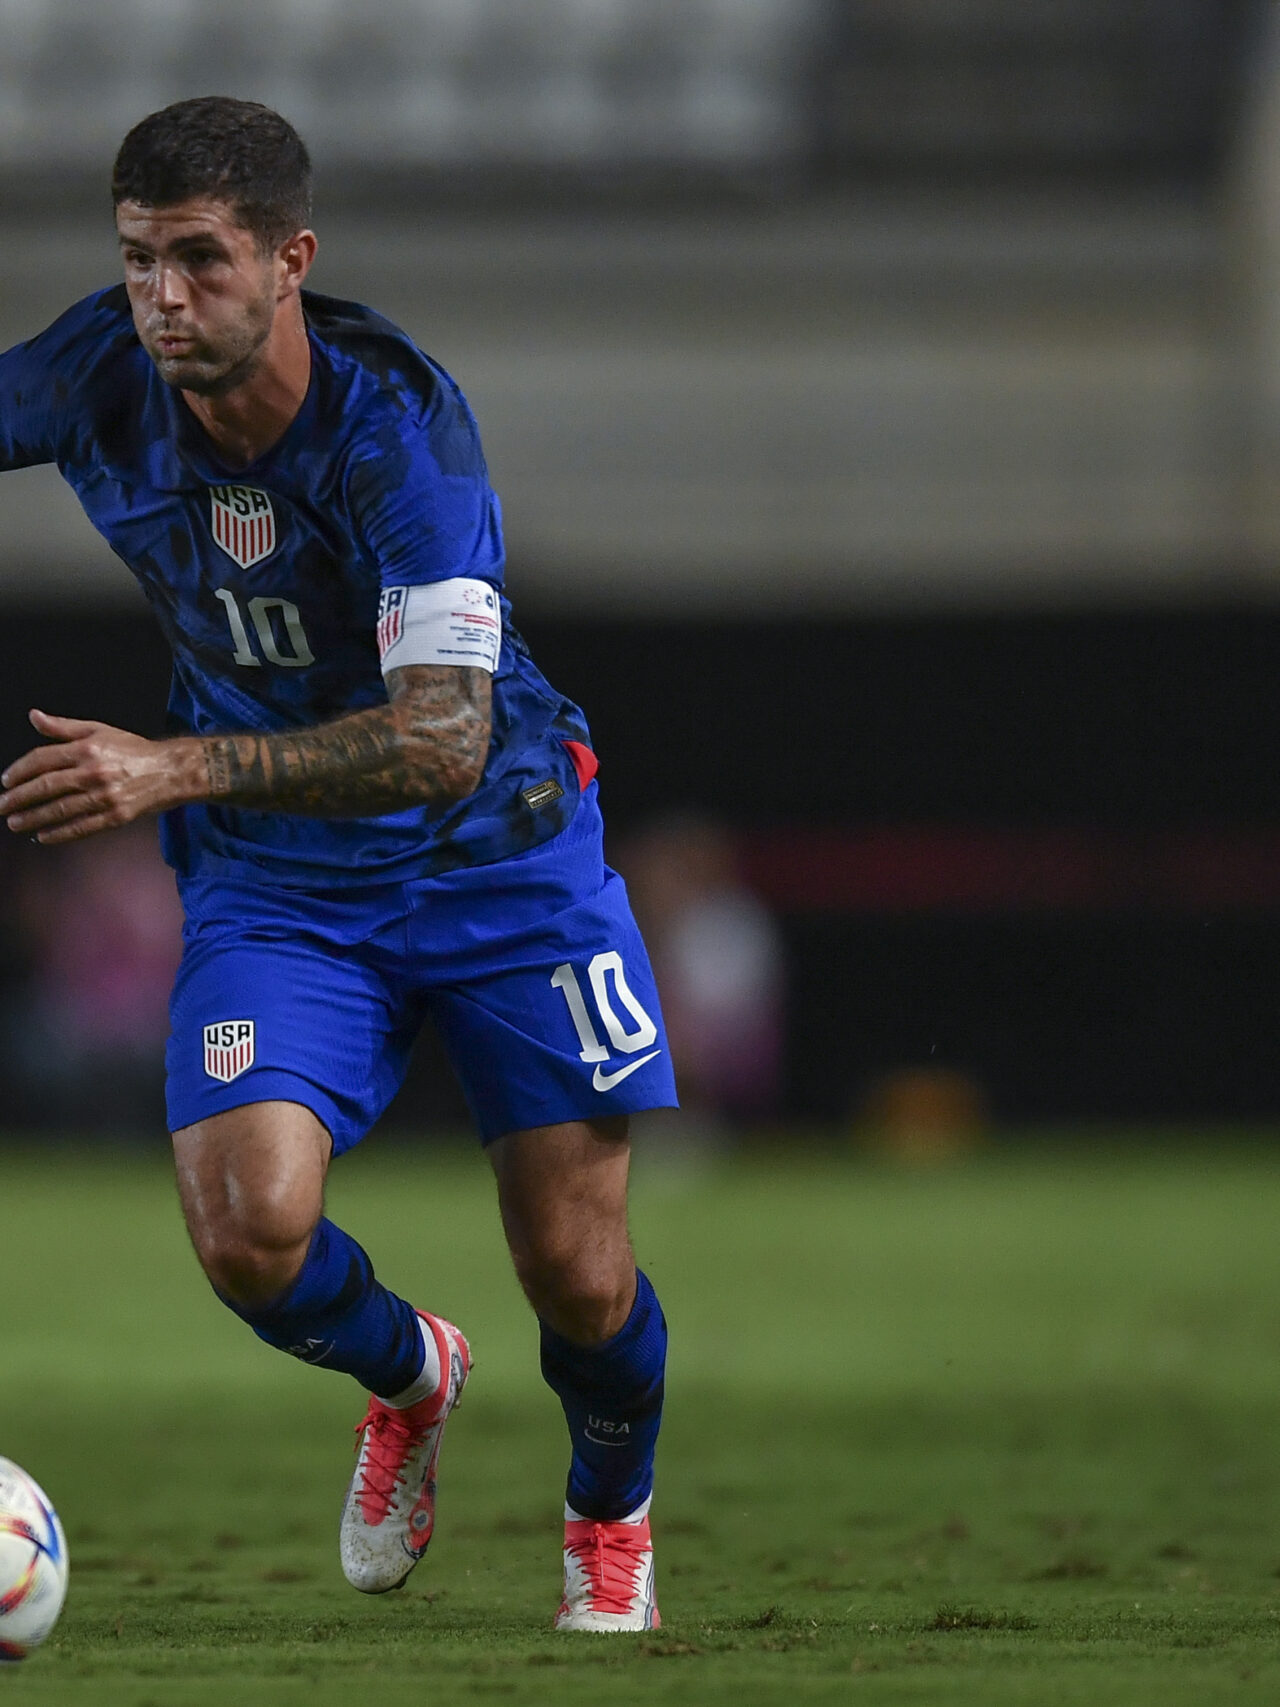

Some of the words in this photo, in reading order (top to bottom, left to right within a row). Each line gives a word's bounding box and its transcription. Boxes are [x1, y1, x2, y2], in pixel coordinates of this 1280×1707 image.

[213, 484, 269, 516] USA
[214, 587, 316, 667] 10
[550, 950, 657, 1063] 10
[206, 1023, 250, 1047] USA
[588, 1414, 630, 1434] USA
